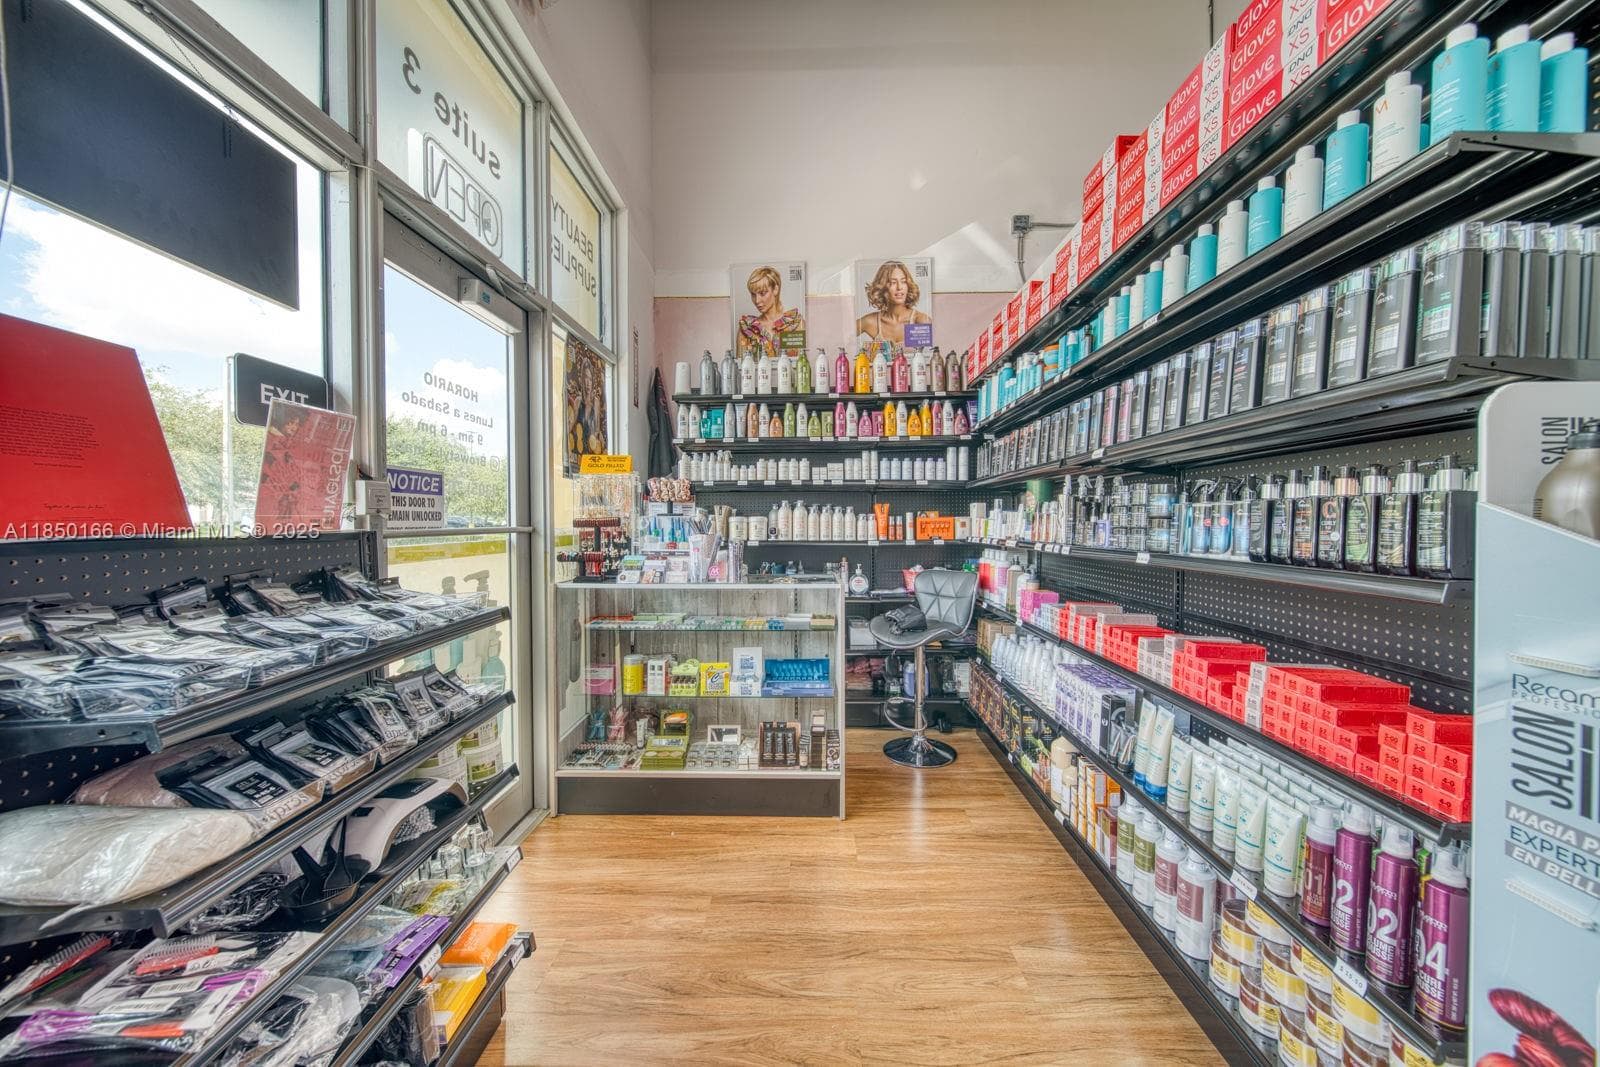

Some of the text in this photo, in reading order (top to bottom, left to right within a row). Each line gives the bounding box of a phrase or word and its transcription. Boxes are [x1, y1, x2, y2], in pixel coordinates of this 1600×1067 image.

[1238, 0, 1272, 38] Glov
[1328, 0, 1376, 48] Glov
[1232, 18, 1276, 73] Glove
[1289, 27, 1310, 56] XS
[1206, 54, 1221, 78] XS
[1288, 45, 1313, 73] DND
[1231, 54, 1275, 105] Glove
[1169, 74, 1200, 117] Glove
[1204, 86, 1219, 109] XS
[1165, 105, 1196, 144] Glove
[1203, 116, 1219, 139] XS
[1230, 89, 1276, 137] Glove
[1122, 138, 1145, 171] Glove
[1163, 132, 1195, 172] Glove
[1120, 166, 1143, 196] Glove
[1161, 163, 1194, 200] Glove
[1083, 188, 1102, 215] Glove
[1119, 190, 1142, 220] Glove
[1082, 211, 1101, 237] Glove
[1117, 216, 1140, 244] Glove
[1080, 233, 1099, 258] Glove
[1079, 255, 1098, 278] Glove
[1052, 286, 1067, 306] Glove
[260, 382, 309, 405] EXIT
[1540, 416, 1569, 465] SALON
[387, 472, 440, 493] NOTICE
[388, 510, 442, 522] EMAIN UNLOCKED
[391, 495, 407, 507] THIS
[408, 496, 426, 508] DOOR
[427, 497, 436, 508] TO
[1511, 705, 1576, 810] SALON
[1507, 805, 1577, 846] MAGIA
[1510, 824, 1600, 879] EXPERT
[1511, 845, 1600, 897] EN BELL
